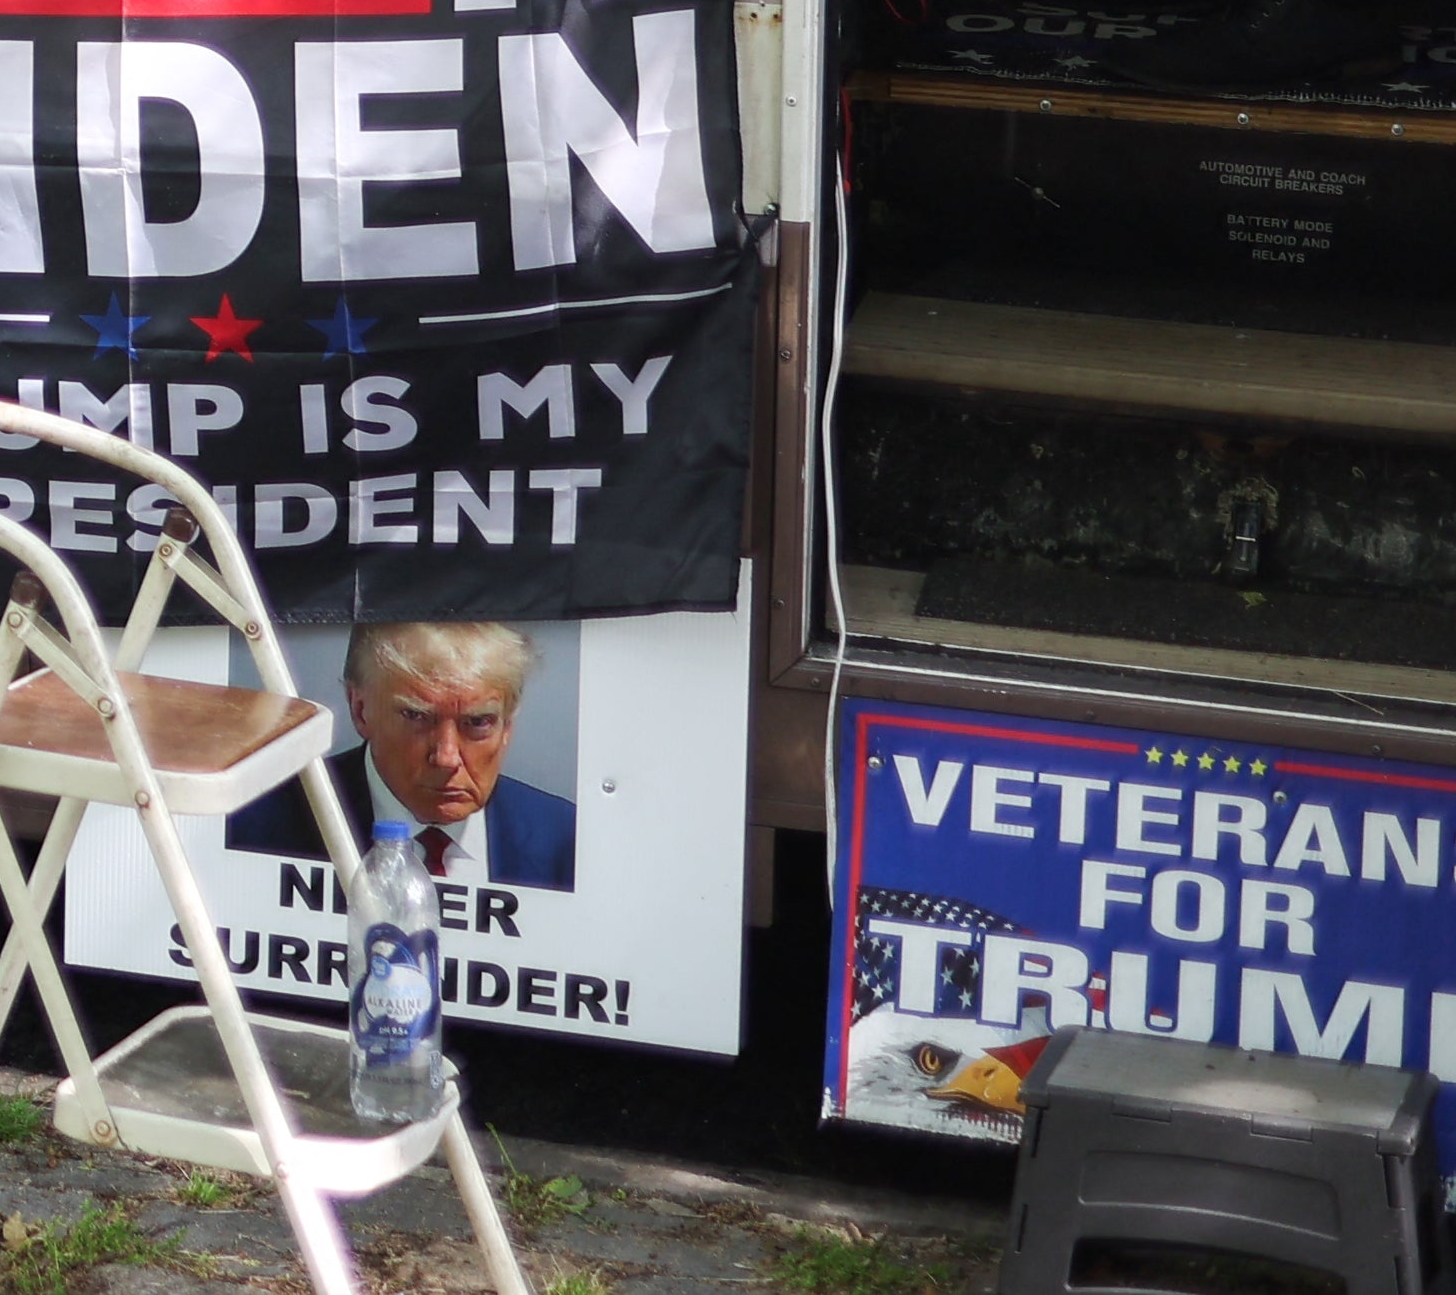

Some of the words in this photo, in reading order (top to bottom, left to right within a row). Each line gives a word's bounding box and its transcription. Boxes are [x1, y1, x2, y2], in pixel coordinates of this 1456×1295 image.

[1198, 160, 1283, 181] AUTOMOTIVE
[1288, 167, 1316, 181] AND
[1320, 171, 1366, 186] COACH
[1220, 173, 1270, 191] CIRCUIT
[1275, 178, 1344, 196] BREAKERS
[301, 377, 418, 456] IS
[477, 354, 673, 441] MY
[893, 755, 1456, 888] VETERAN
[1080, 860, 1315, 956] FOR
